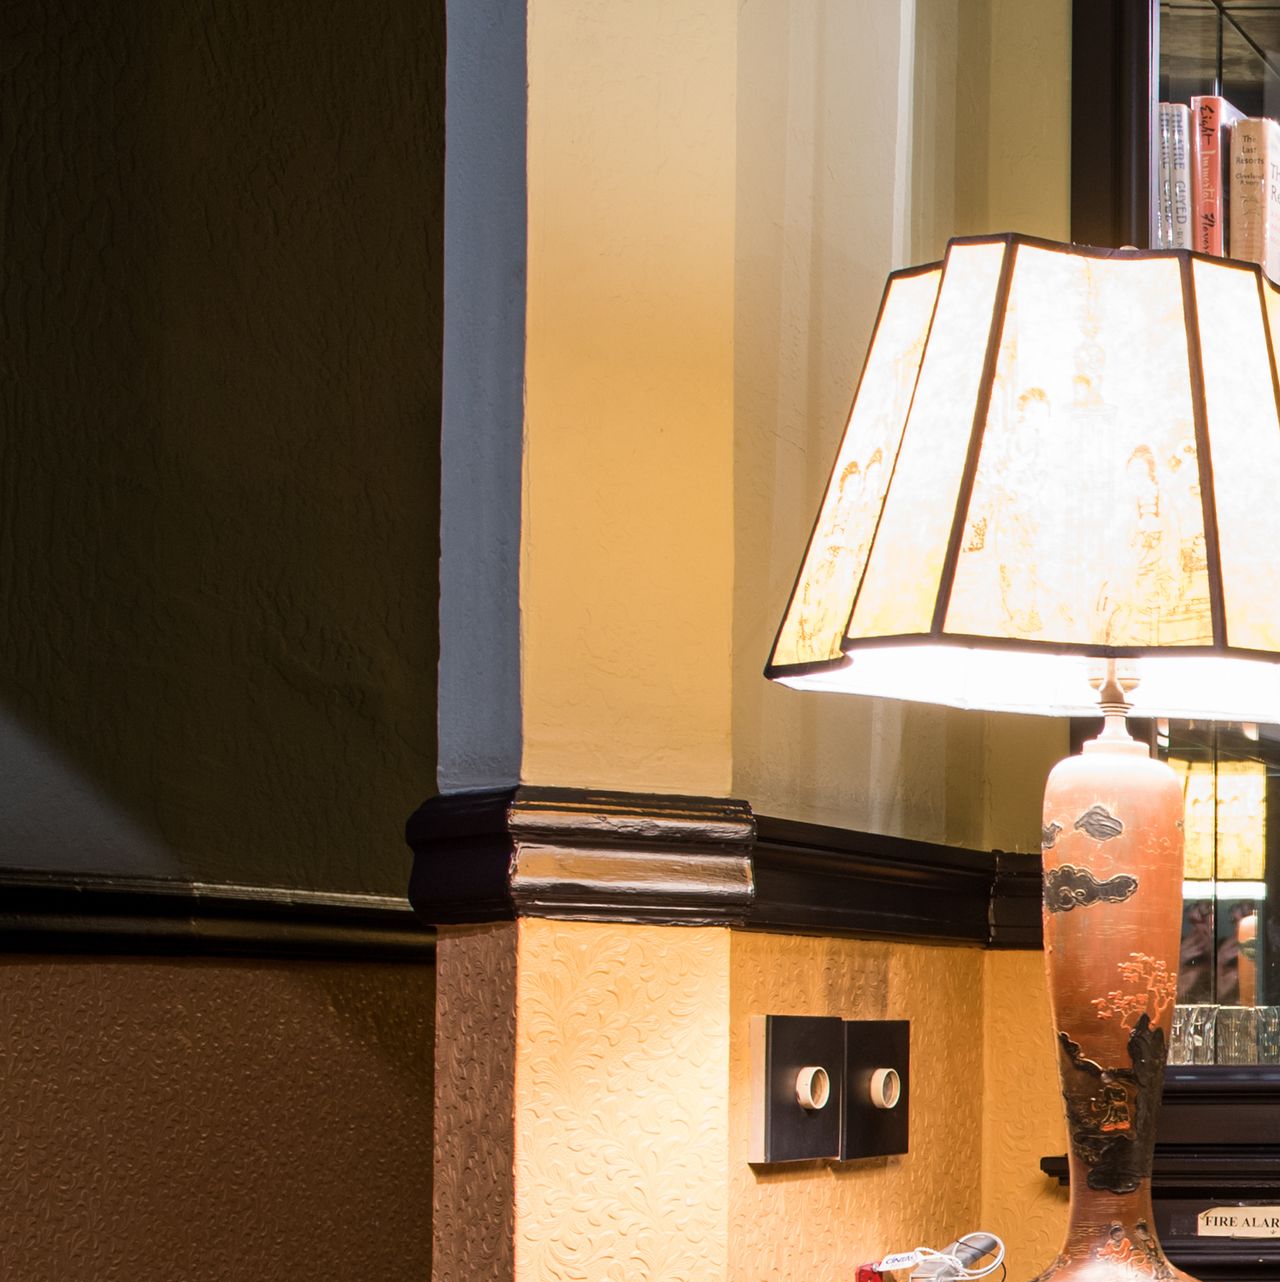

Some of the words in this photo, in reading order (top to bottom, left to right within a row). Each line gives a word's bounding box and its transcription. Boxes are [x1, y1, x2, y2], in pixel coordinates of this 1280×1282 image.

[1199, 104, 1216, 145] Eight
[1242, 135, 1257, 143] The
[1242, 145, 1257, 154] Last
[1235, 157, 1265, 165] Resorts
[1200, 149, 1216, 203] Immortal
[1205, 1216, 1238, 1227] FIRE
